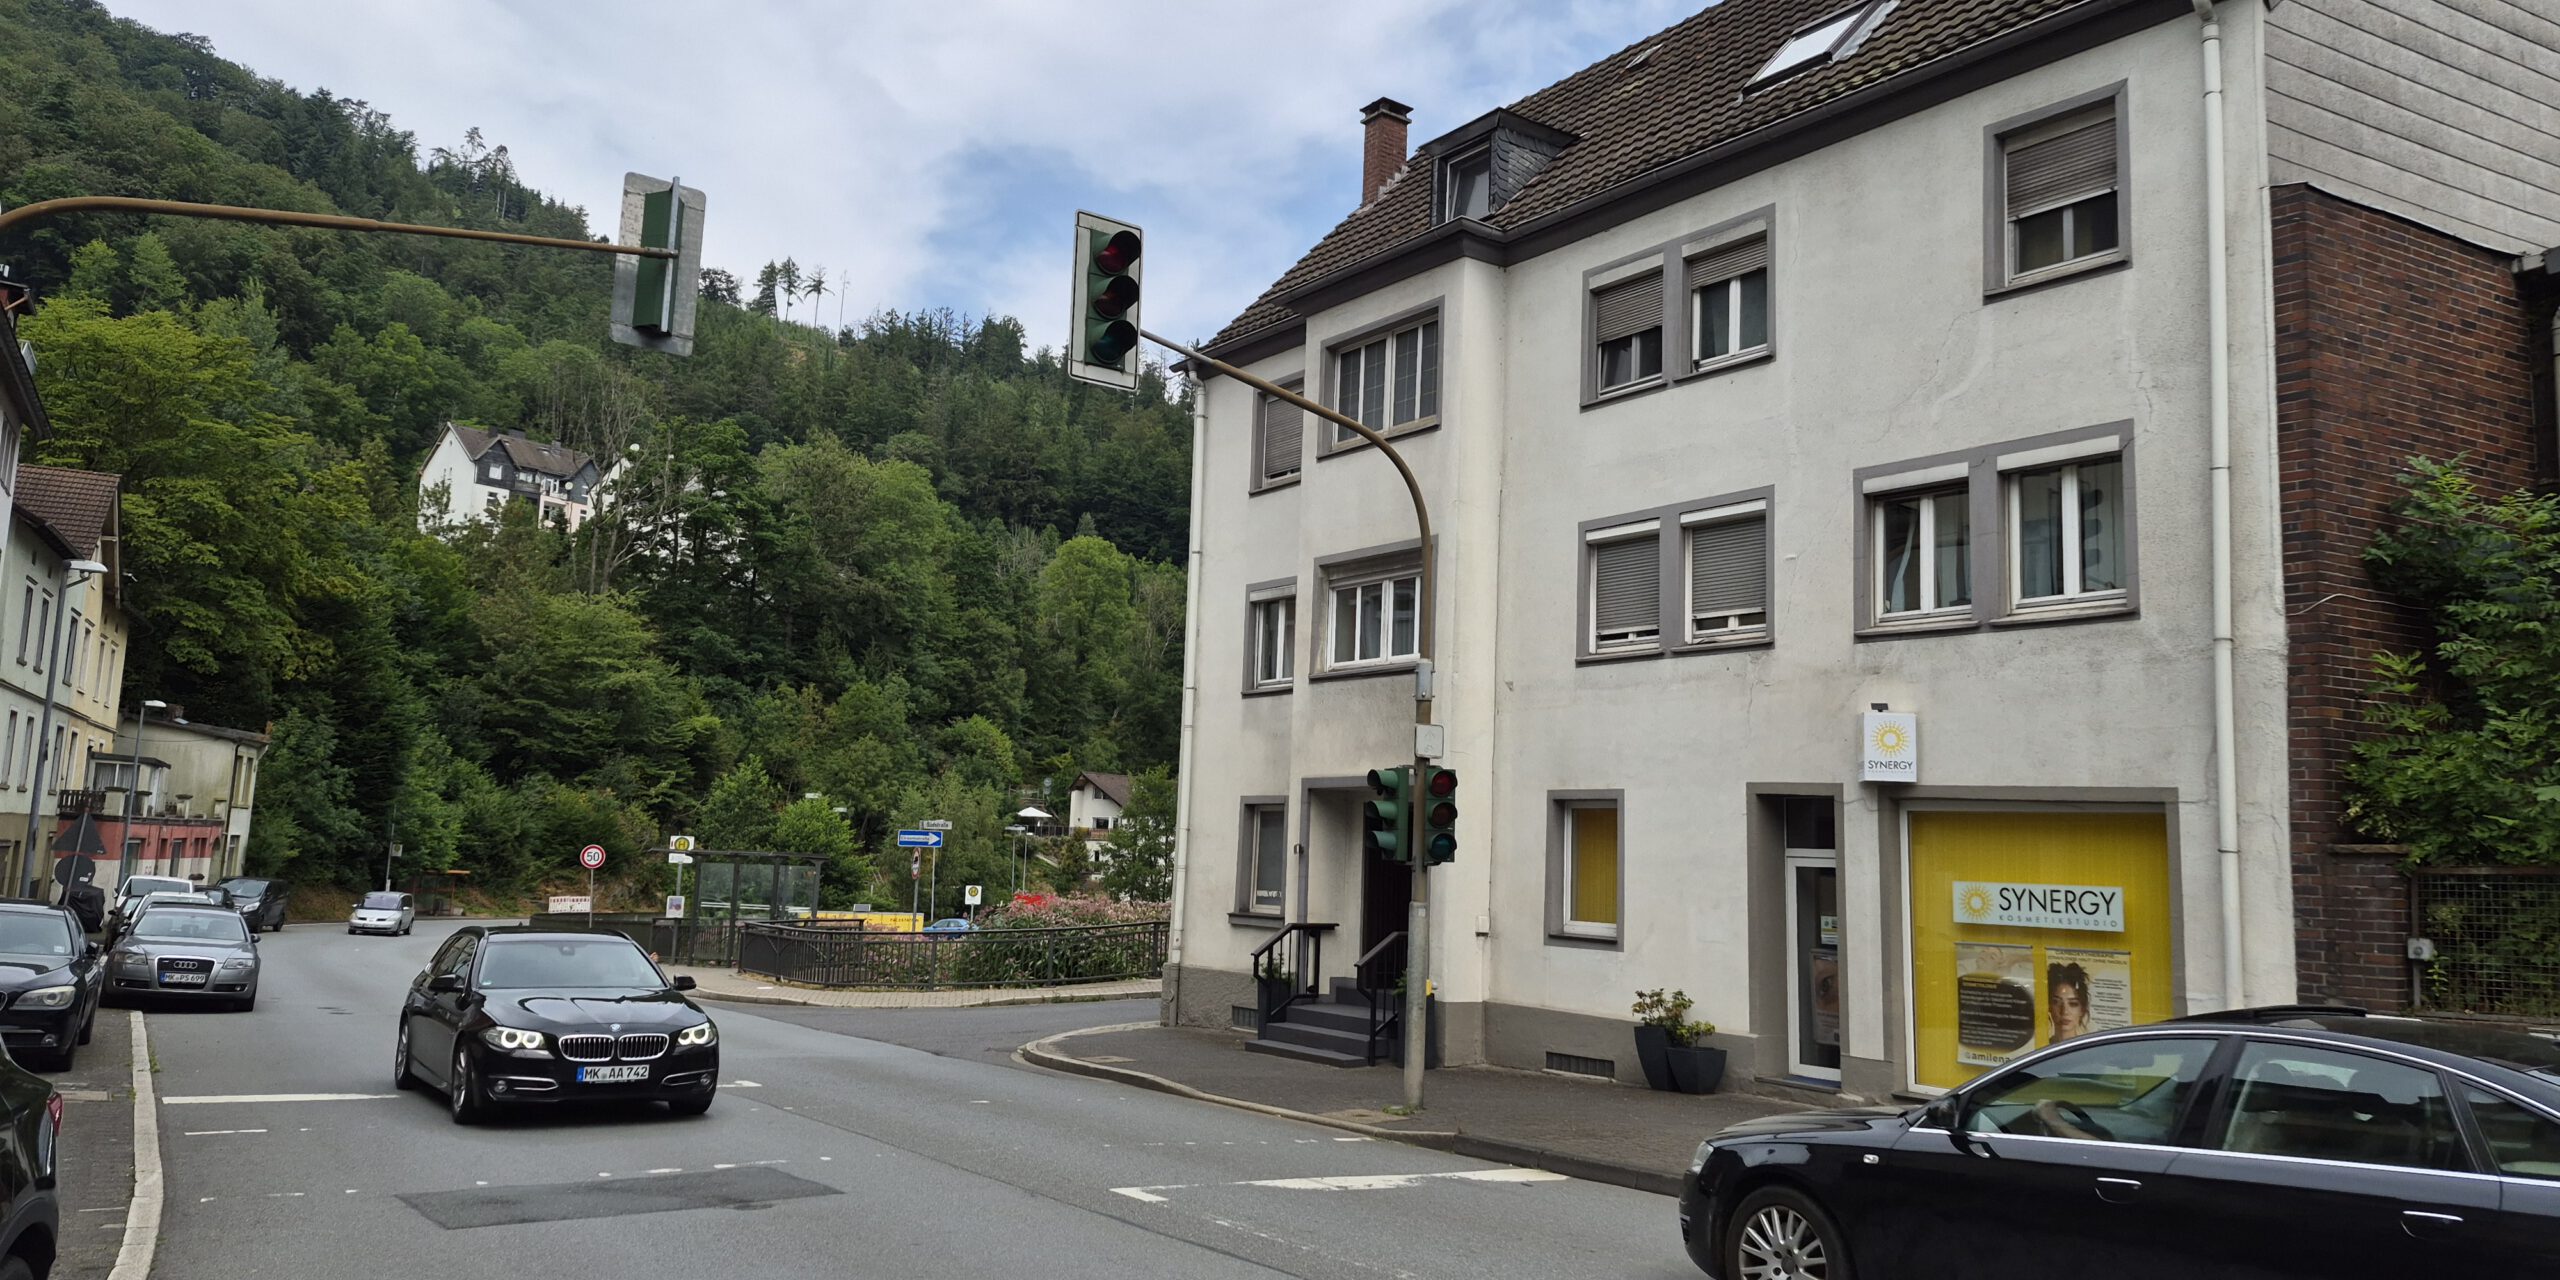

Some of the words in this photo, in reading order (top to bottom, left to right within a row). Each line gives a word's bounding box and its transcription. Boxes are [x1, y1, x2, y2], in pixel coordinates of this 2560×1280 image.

[1868, 760, 1913, 770] SYNERGY
[586, 851, 600, 862] 50
[1999, 887, 2116, 916] SYNERGY
[1999, 915, 2118, 928] KOSMETIKSTUDIO
[585, 1068, 601, 1079] MK
[608, 1067, 624, 1079] AA
[626, 1066, 648, 1078] 742
